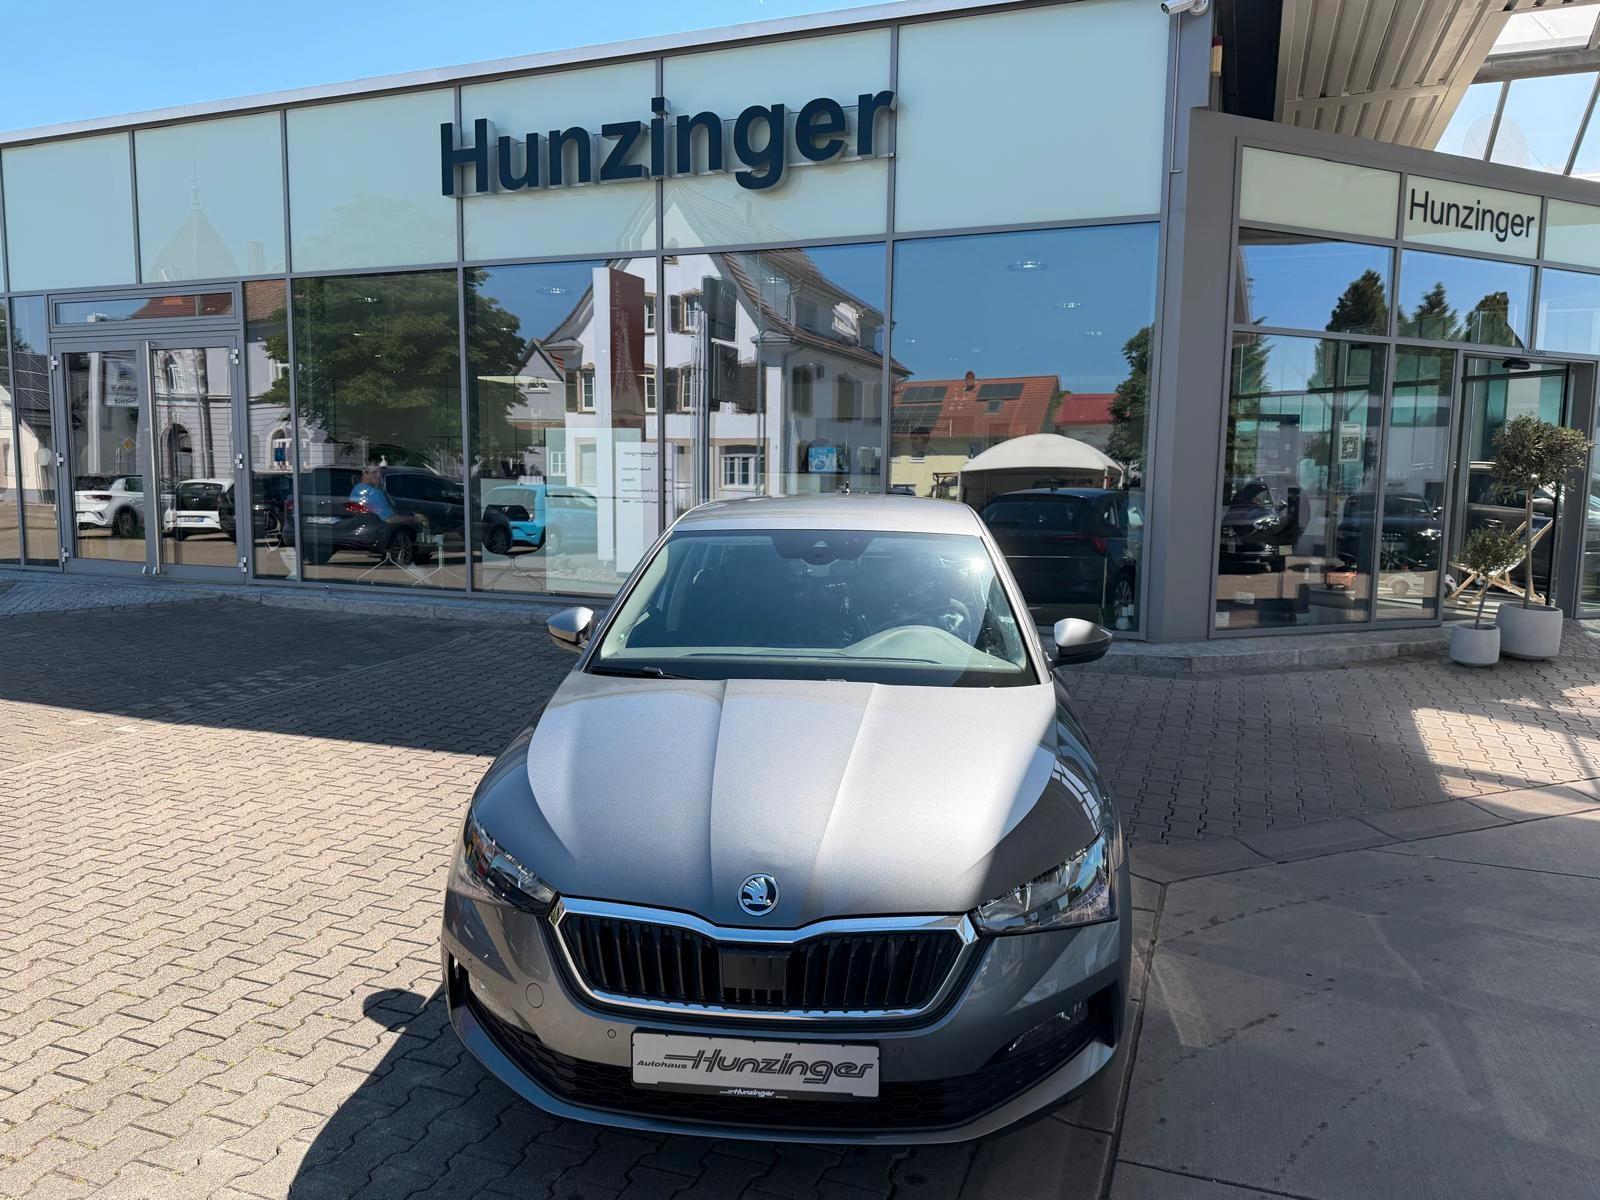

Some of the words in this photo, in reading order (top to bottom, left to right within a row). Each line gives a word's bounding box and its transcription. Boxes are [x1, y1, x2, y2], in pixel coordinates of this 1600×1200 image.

[441, 90, 896, 196] Hunzinger
[1409, 188, 1535, 243] Hunzinger
[636, 1060, 688, 1069] Autohaus
[664, 1049, 874, 1085] Hunzinger
[720, 1087, 775, 1098] Hunzinger
